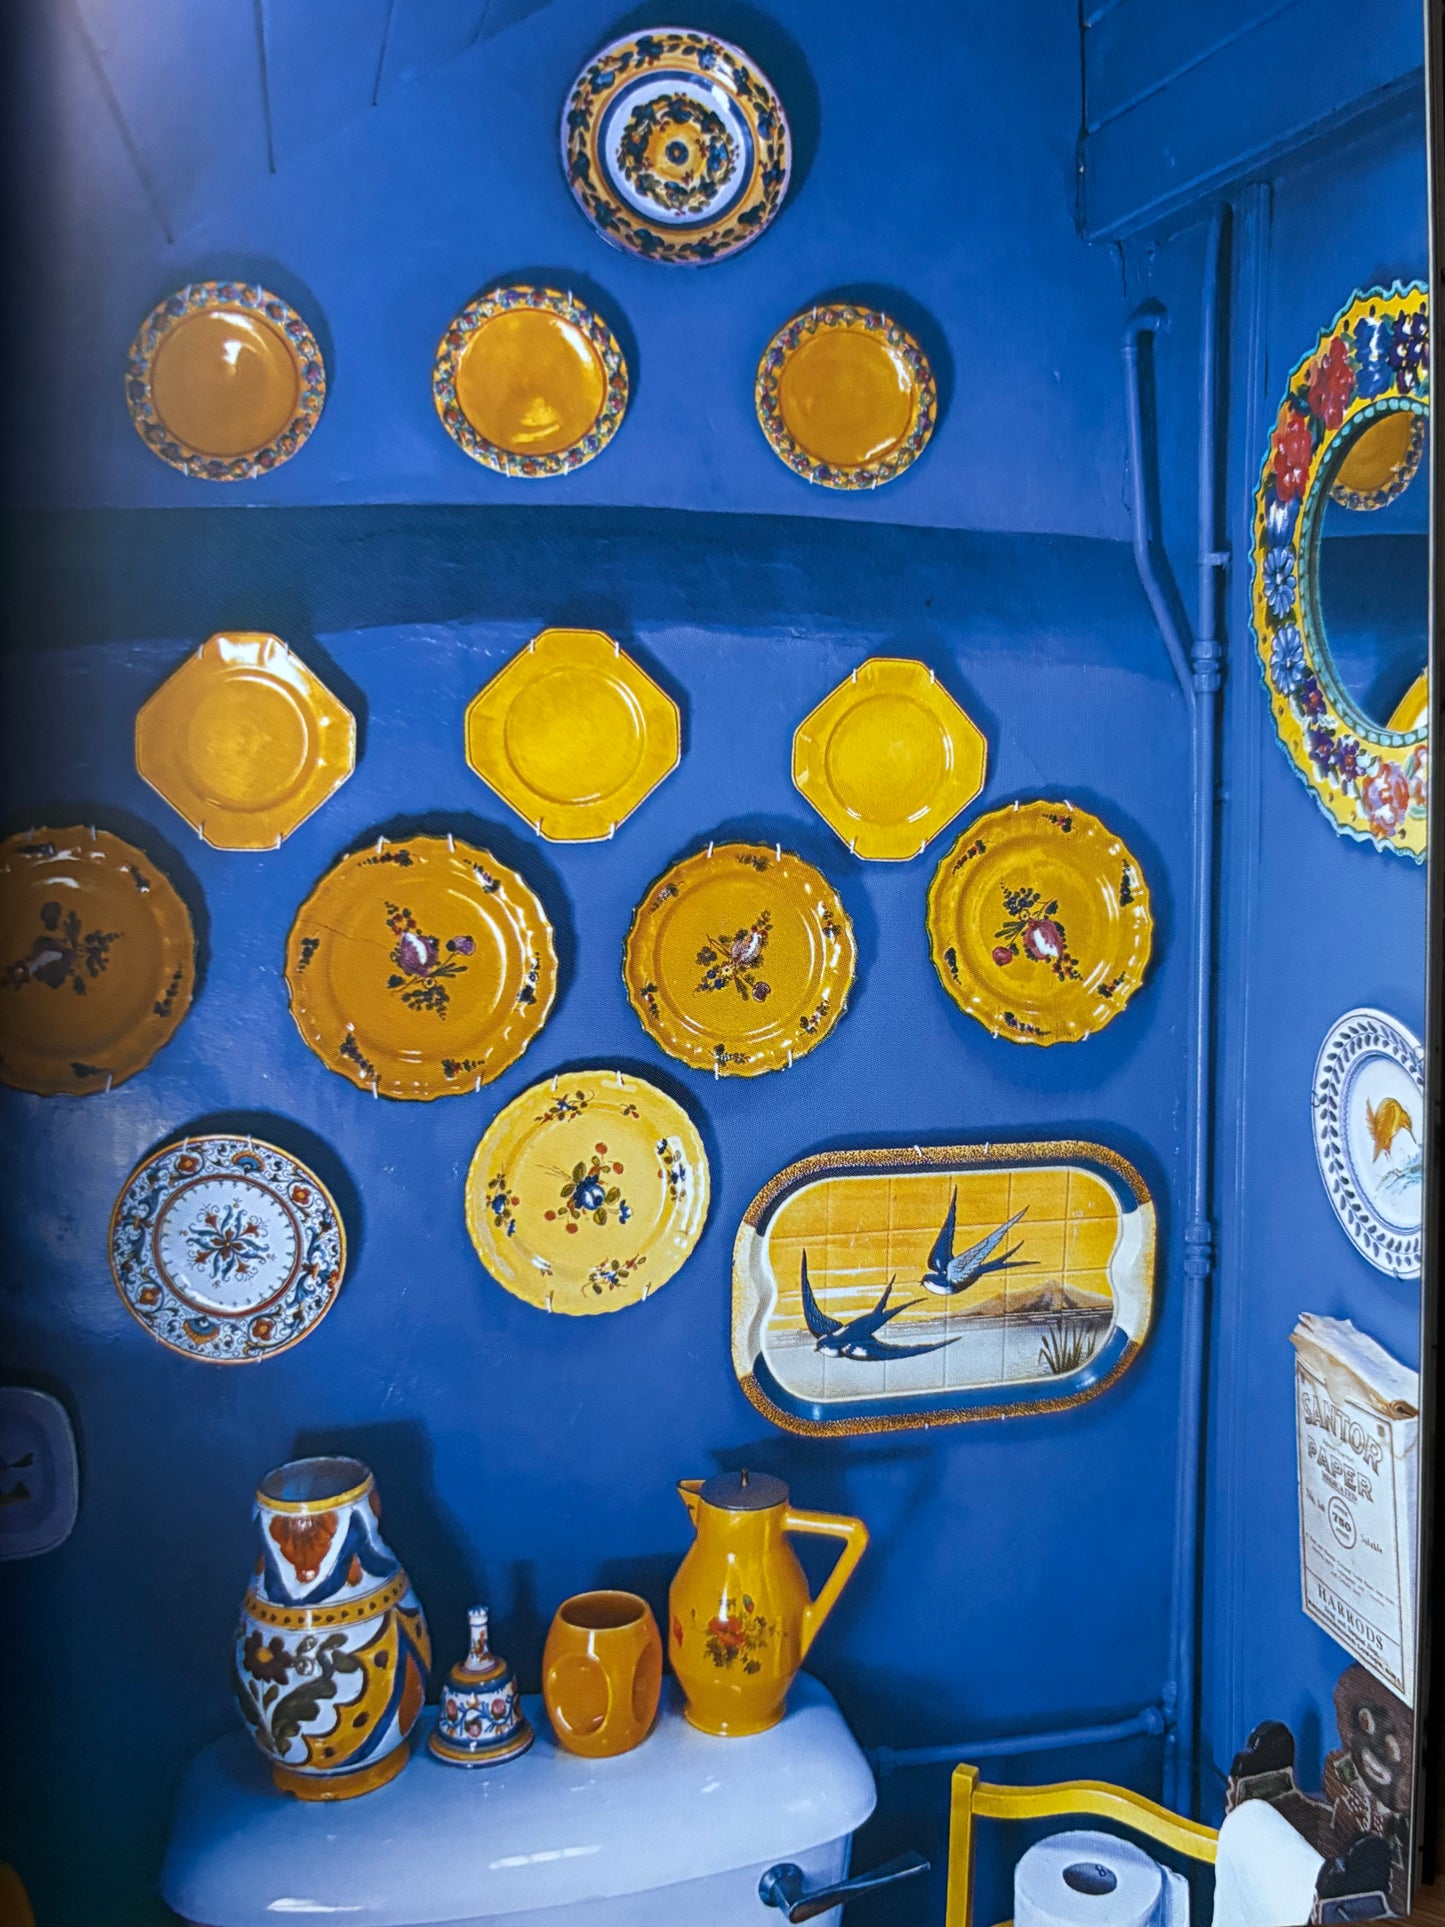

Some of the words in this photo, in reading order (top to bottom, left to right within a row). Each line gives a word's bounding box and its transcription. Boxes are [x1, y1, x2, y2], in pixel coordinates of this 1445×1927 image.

[1307, 1434, 1375, 1503] PAPER
[1318, 1583, 1384, 1650] HARRODS
[1095, 1864, 1107, 1877] 8
